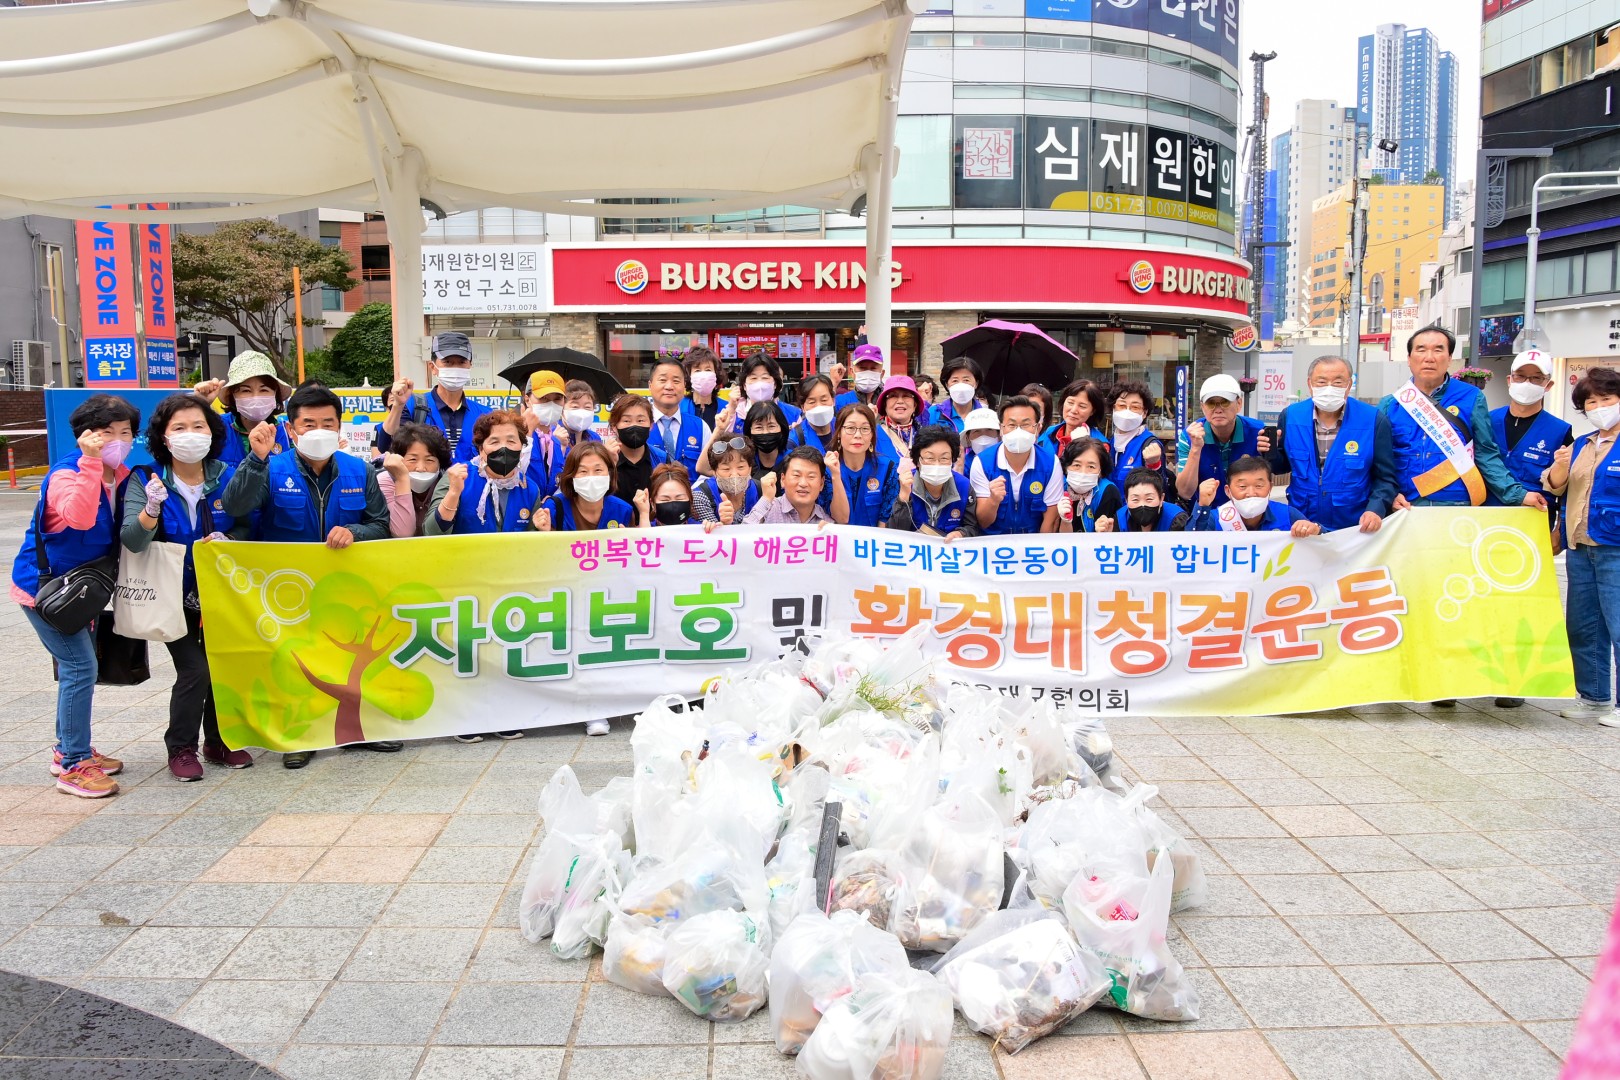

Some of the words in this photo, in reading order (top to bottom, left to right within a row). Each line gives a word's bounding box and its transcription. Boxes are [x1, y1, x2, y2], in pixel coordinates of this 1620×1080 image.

[1095, 195, 1184, 218] 051.731.0078
[422, 252, 514, 271] 재원한의원
[520, 254, 535, 266] 2F
[619, 266, 643, 279] BURGER
[620, 274, 645, 286] KING
[660, 261, 803, 290] BURGER
[814, 261, 903, 289] KING
[1133, 266, 1151, 277] BURGER
[1134, 273, 1152, 283] KING
[95, 256, 119, 325] ZONE
[521, 282, 534, 293] B1
[1162, 265, 1233, 299] BURGER
[150, 258, 165, 327] ZONE
[1233, 332, 1254, 346] KING
[89, 343, 132, 360] 주차장
[1528, 352, 1541, 361] T
[97, 360, 127, 377] 출구
[1264, 374, 1286, 391] 5%
[570, 536, 664, 571] 행복한
[678, 537, 737, 566] 도시
[753, 534, 838, 565] 해운대
[853, 539, 1078, 575] 바르게살기운동이
[1093, 544, 1154, 574] 함께
[1171, 543, 1261, 574] 합니다
[393, 582, 748, 676] 자연보호
[771, 594, 823, 662] 및
[850, 568, 1405, 677] 환경대청결운동
